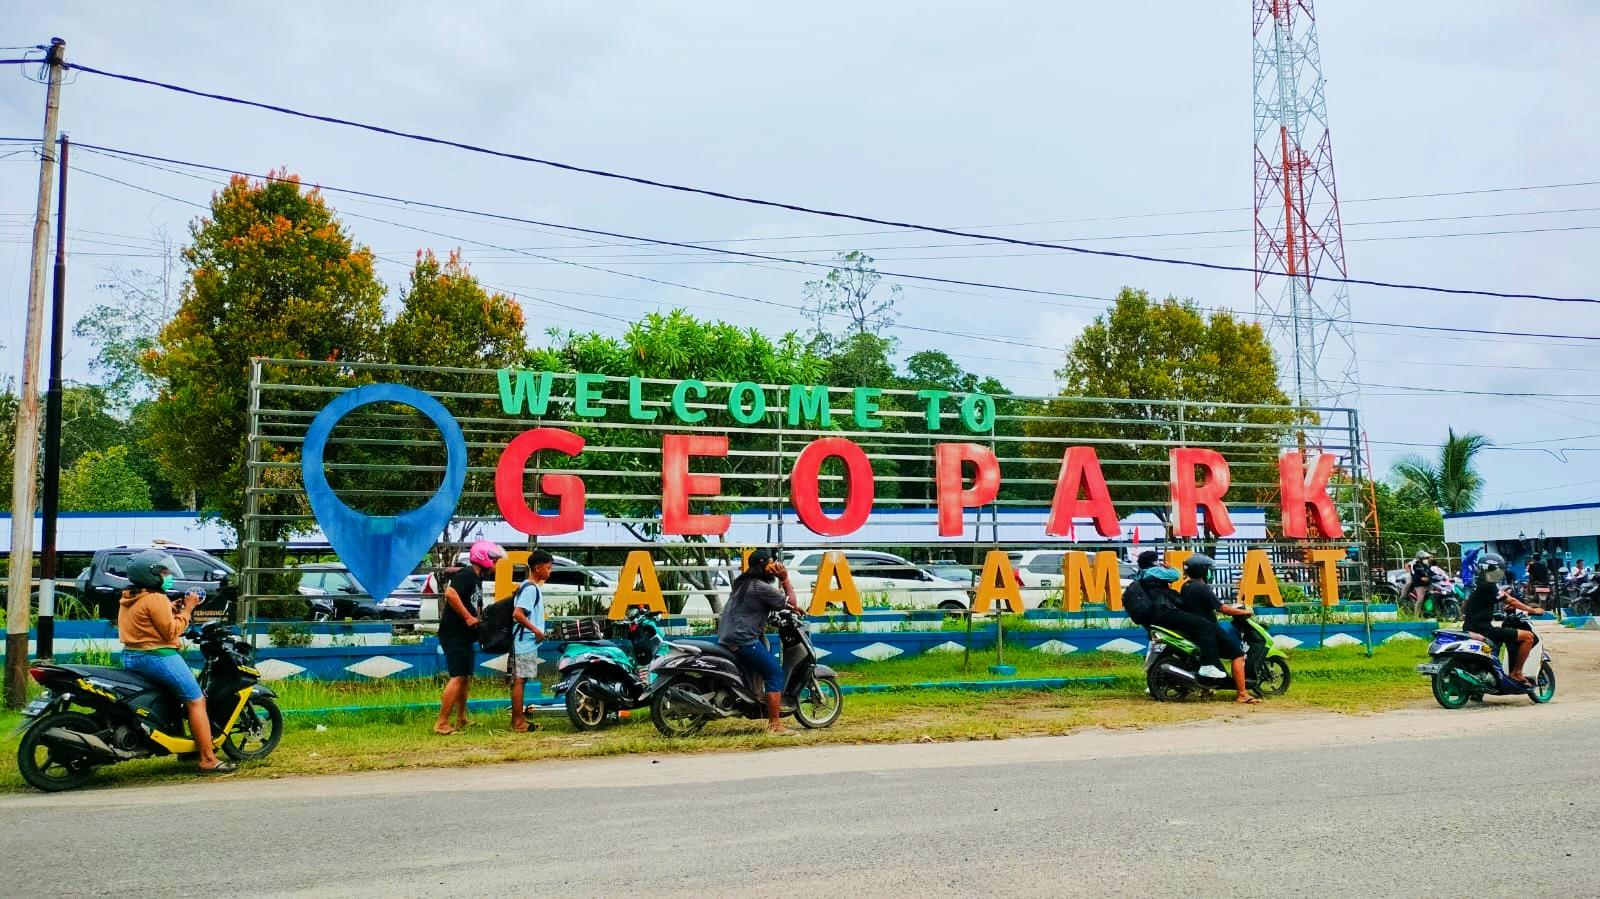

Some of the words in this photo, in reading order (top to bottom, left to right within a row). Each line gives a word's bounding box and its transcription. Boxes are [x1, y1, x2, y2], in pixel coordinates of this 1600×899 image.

[496, 369, 884, 429] WELCOME
[916, 388, 997, 433] TO
[494, 426, 1344, 540] GEOPARK
[494, 551, 863, 621] AA
